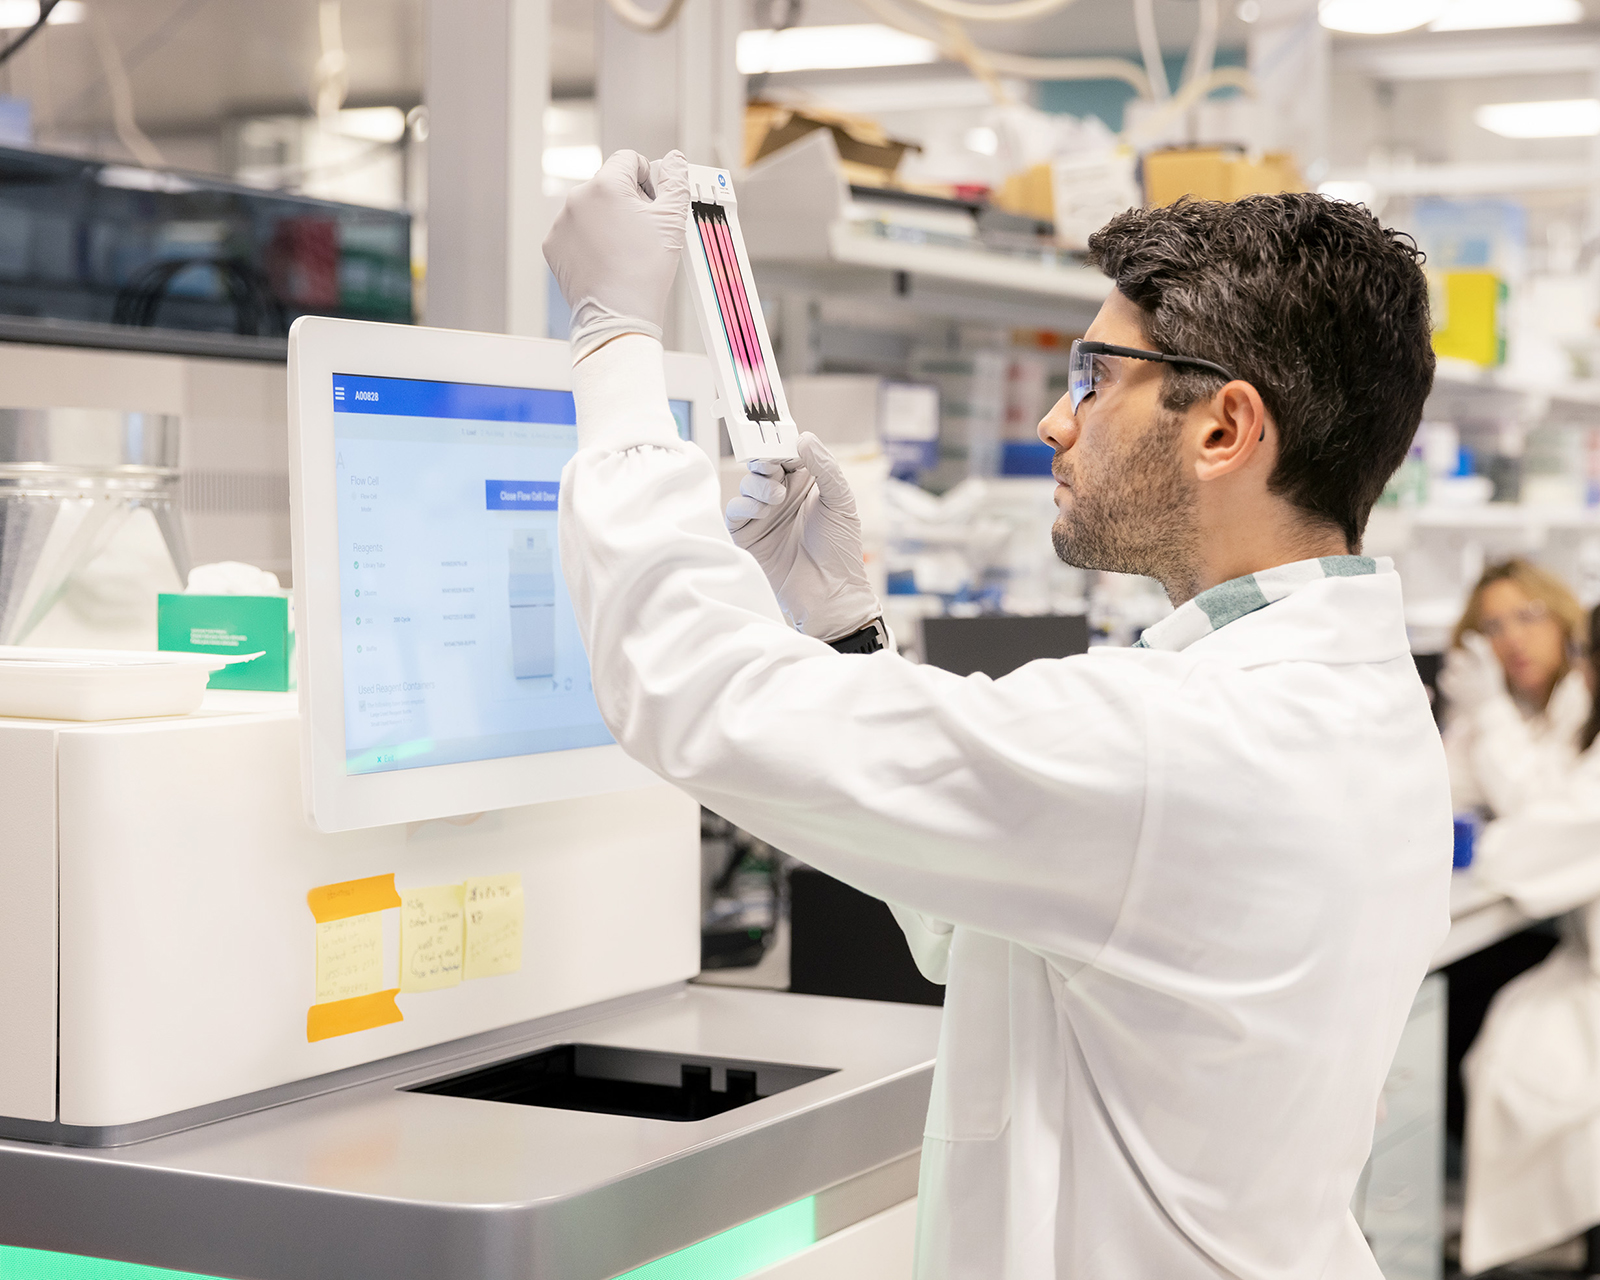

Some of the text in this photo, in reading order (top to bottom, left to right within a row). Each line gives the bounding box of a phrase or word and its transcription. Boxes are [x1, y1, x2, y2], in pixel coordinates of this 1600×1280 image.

[355, 391, 379, 402] A00828
[336, 452, 345, 469] A
[350, 475, 379, 486] Flow Cell
[500, 490, 517, 501] Close
[517, 490, 531, 501] Flow
[531, 491, 542, 501] Cell
[353, 542, 383, 555] Reagents
[358, 682, 435, 694] Used Reagent Containers
[383, 754, 394, 762] Exit
